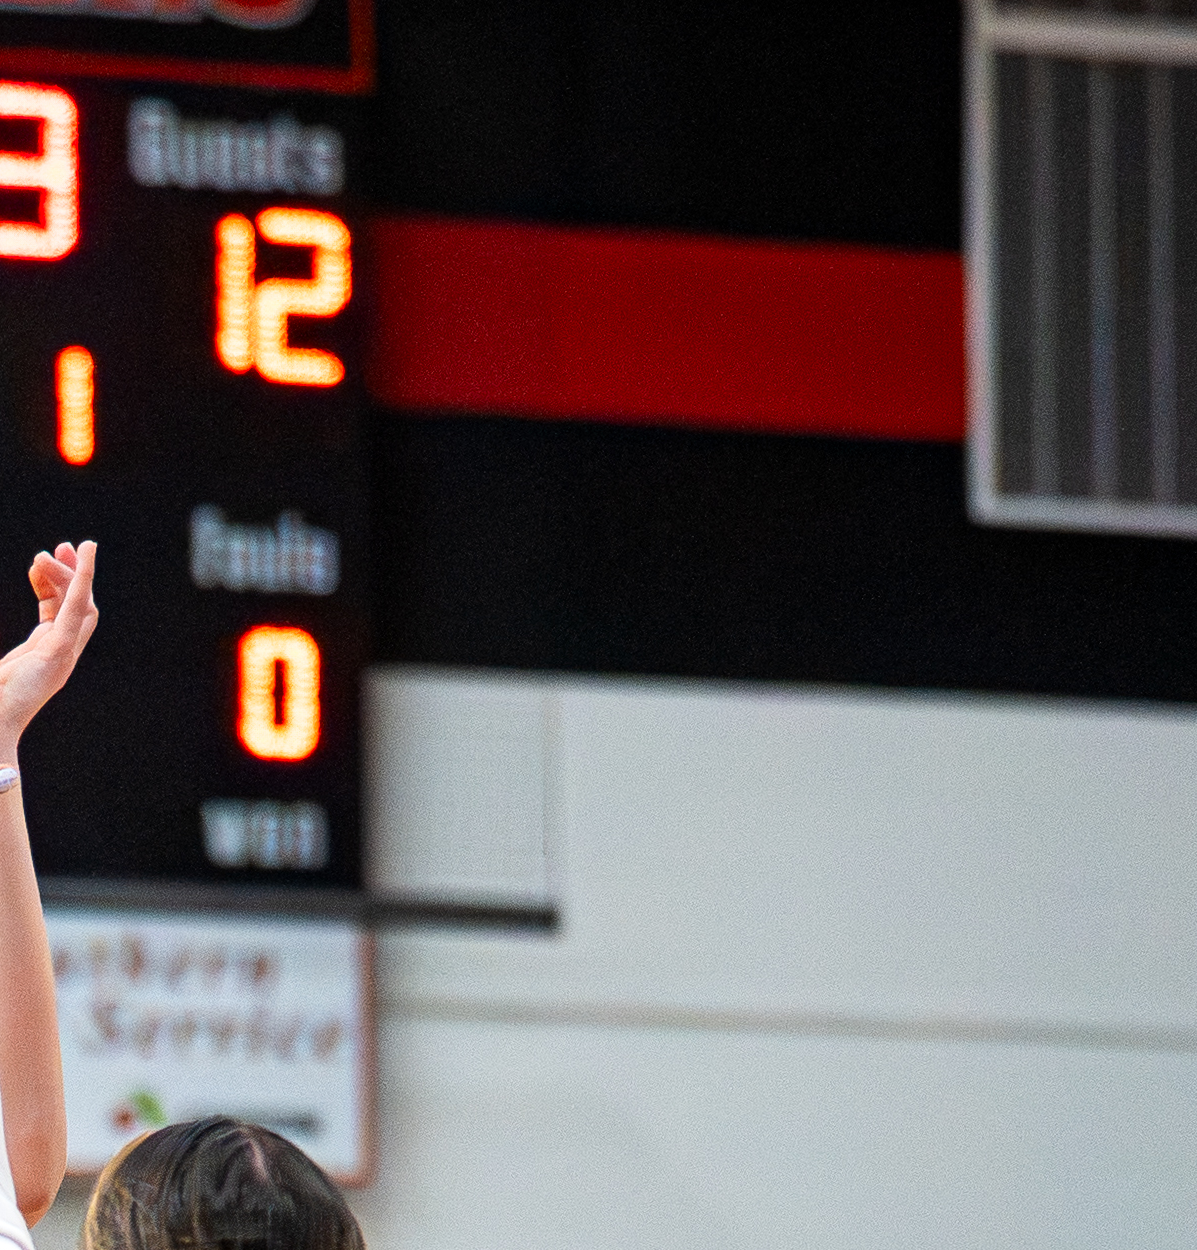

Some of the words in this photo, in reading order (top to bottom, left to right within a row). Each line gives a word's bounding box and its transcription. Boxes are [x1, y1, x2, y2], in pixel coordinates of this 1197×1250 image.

[215, 207, 351, 387] 12
[55, 345, 95, 466] 1
[236, 625, 322, 762] 0
